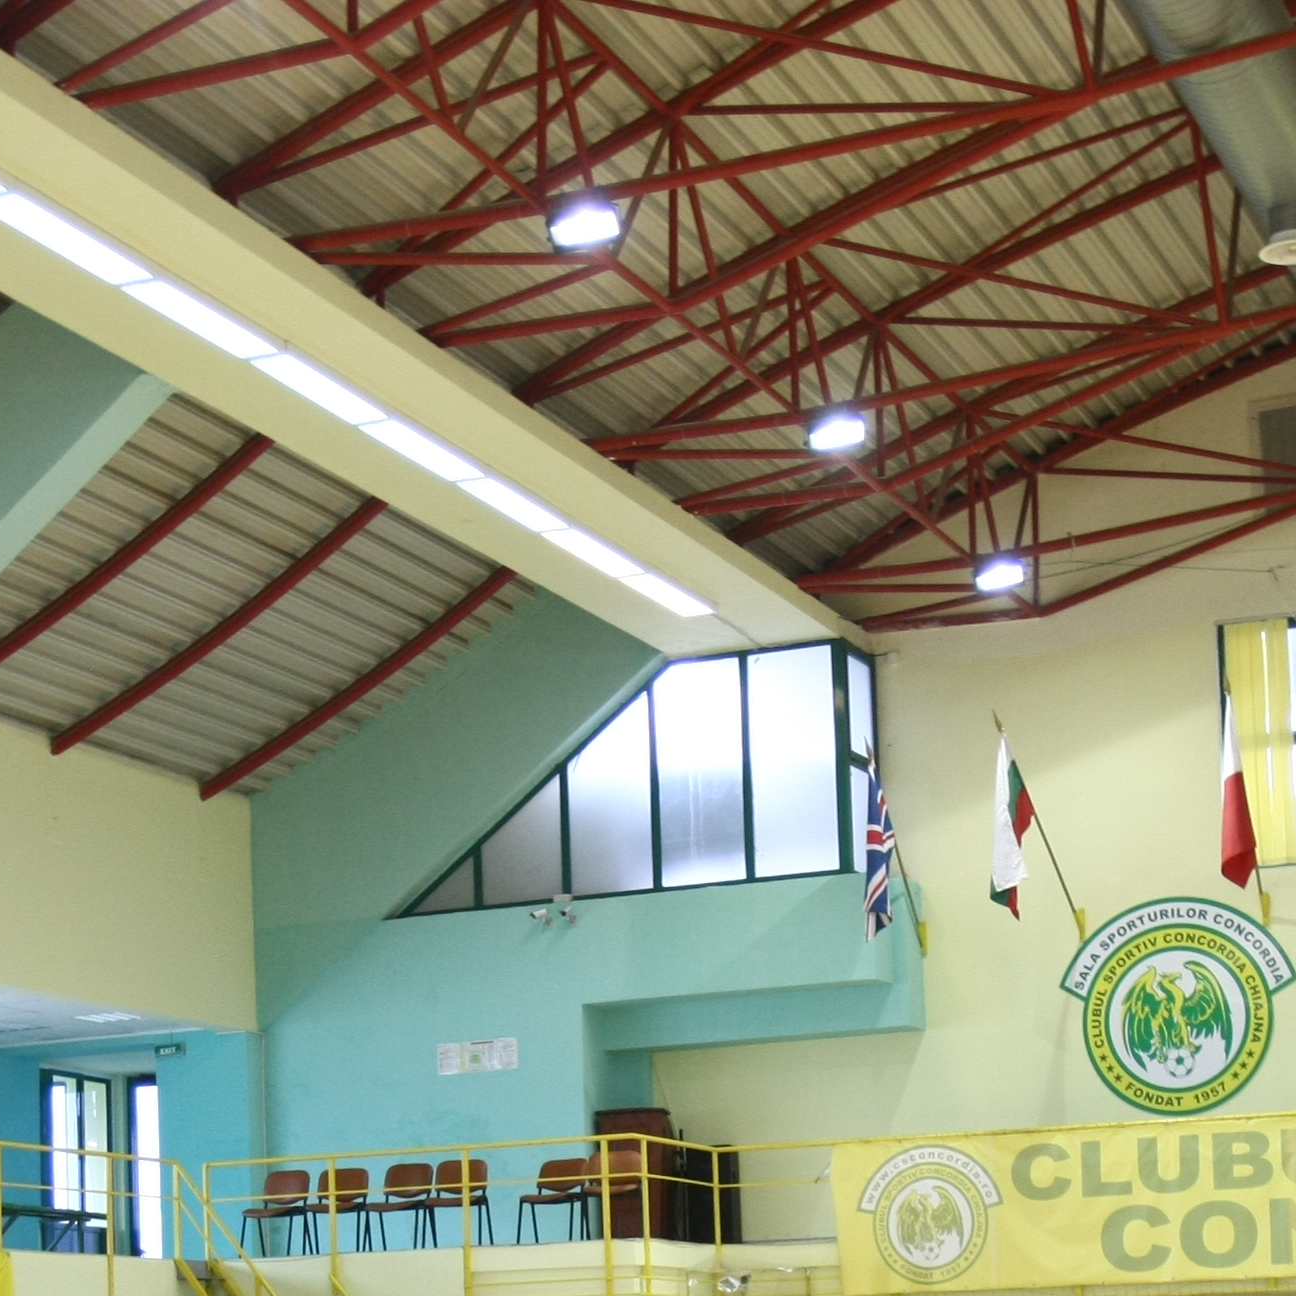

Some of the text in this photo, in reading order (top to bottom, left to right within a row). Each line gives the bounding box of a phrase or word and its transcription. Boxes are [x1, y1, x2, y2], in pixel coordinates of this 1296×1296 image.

[1074, 907, 1286, 991] SALA SPORTURILOR CONCORDIA
[1091, 932, 1265, 1049] CLUBUL SPORTIV CONCORDIA CHIAJNA
[1125, 1082, 1227, 1107] FONDAT 1957
